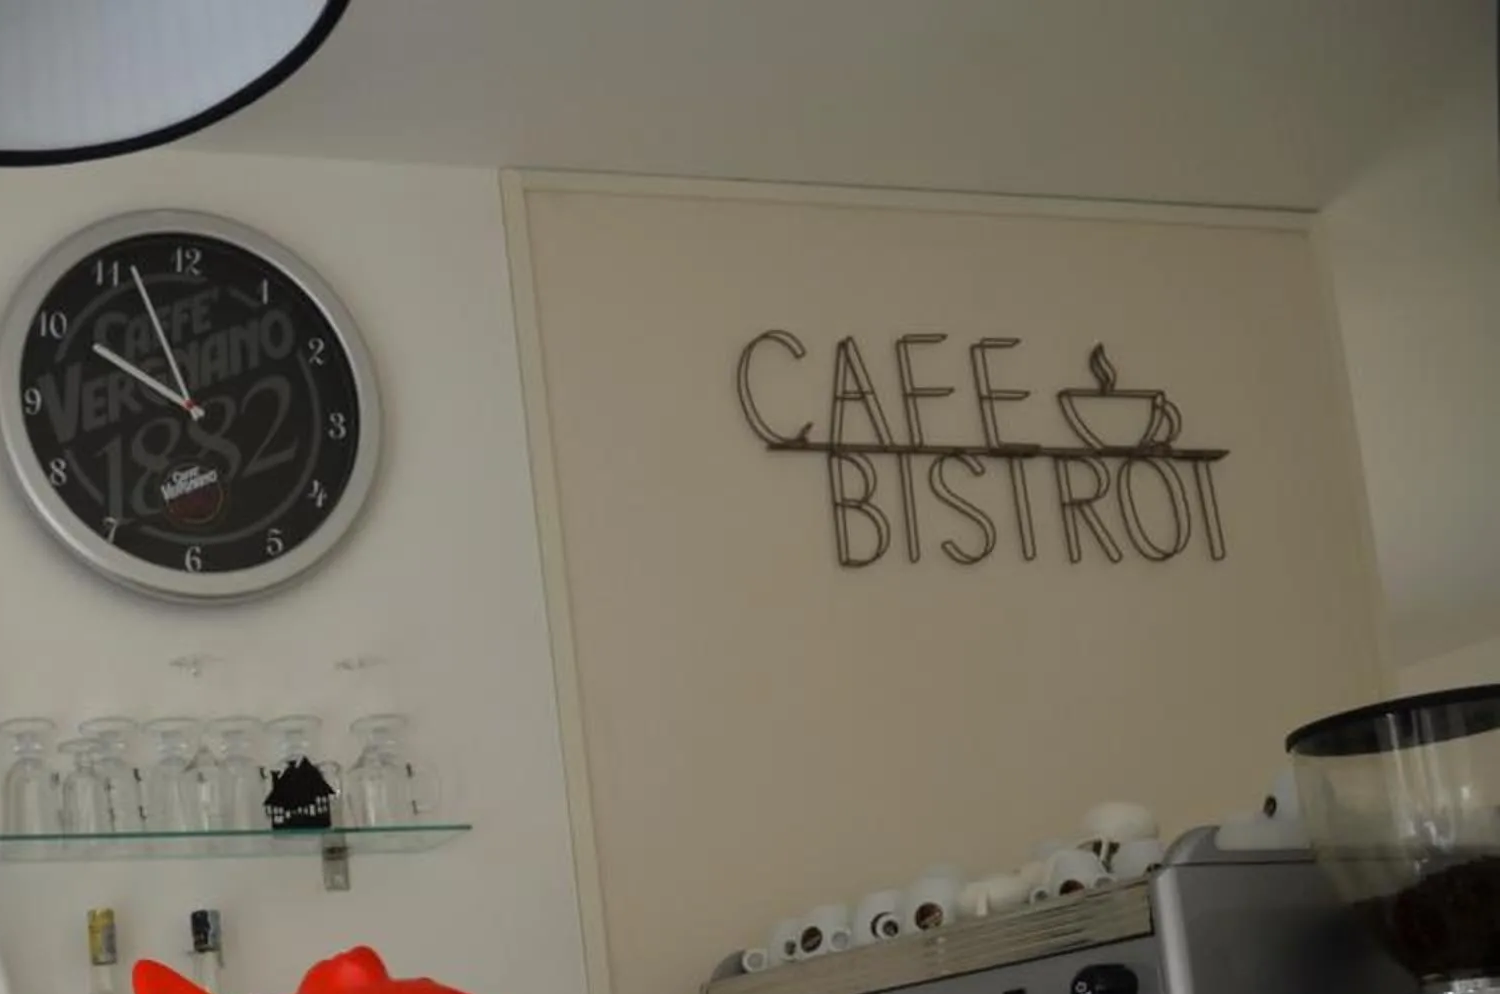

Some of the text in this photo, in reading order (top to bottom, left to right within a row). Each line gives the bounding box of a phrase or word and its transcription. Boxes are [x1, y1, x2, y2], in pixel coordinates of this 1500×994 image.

[94, 260, 120, 287] 11
[172, 246, 201, 277] 12
[261, 279, 270, 305] 1
[39, 310, 67, 339] 10
[308, 338, 325, 366] 2
[36, 307, 295, 445] VERGNANO
[736, 328, 1032, 450] CAFE
[23, 388, 42, 415] 9
[328, 412, 347, 440] 3
[97, 374, 300, 524] 1882
[49, 458, 67, 487] 8
[308, 479, 328, 508] 4
[827, 446, 1230, 568] BISTROT
[102, 516, 118, 544] 7
[265, 528, 284, 555] 5
[184, 545, 202, 573] 6
